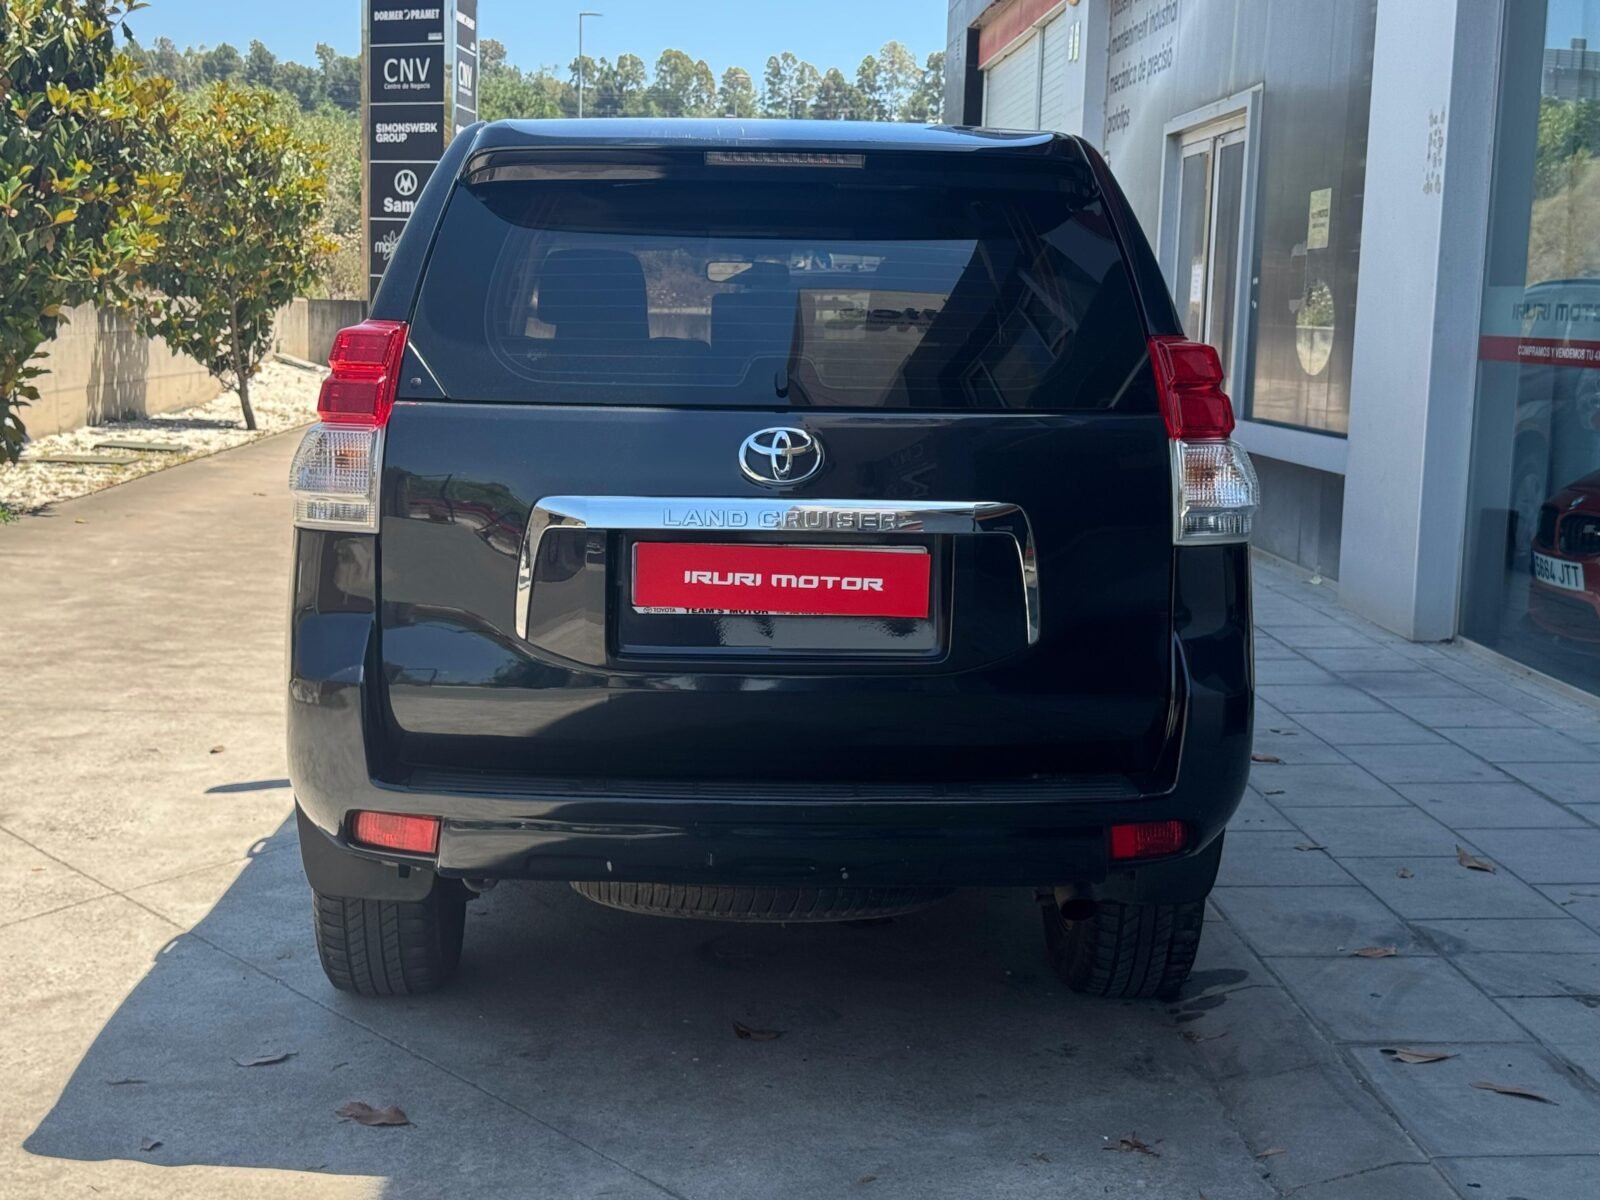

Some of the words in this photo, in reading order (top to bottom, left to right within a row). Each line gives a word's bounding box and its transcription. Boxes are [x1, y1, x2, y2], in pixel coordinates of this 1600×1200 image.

[374, 10, 404, 21] DORMER
[410, 8, 440, 20] PRAMET
[383, 57, 431, 83] CNV
[375, 122, 438, 133] SIMONSWERK
[375, 133, 408, 143] GROUP
[383, 197, 417, 213] Sam
[662, 508, 748, 528] LAND
[758, 509, 897, 530] CRUISER
[684, 570, 762, 587] IRURI
[771, 574, 883, 592] MOTOR
[1559, 563, 1579, 587] JTT
